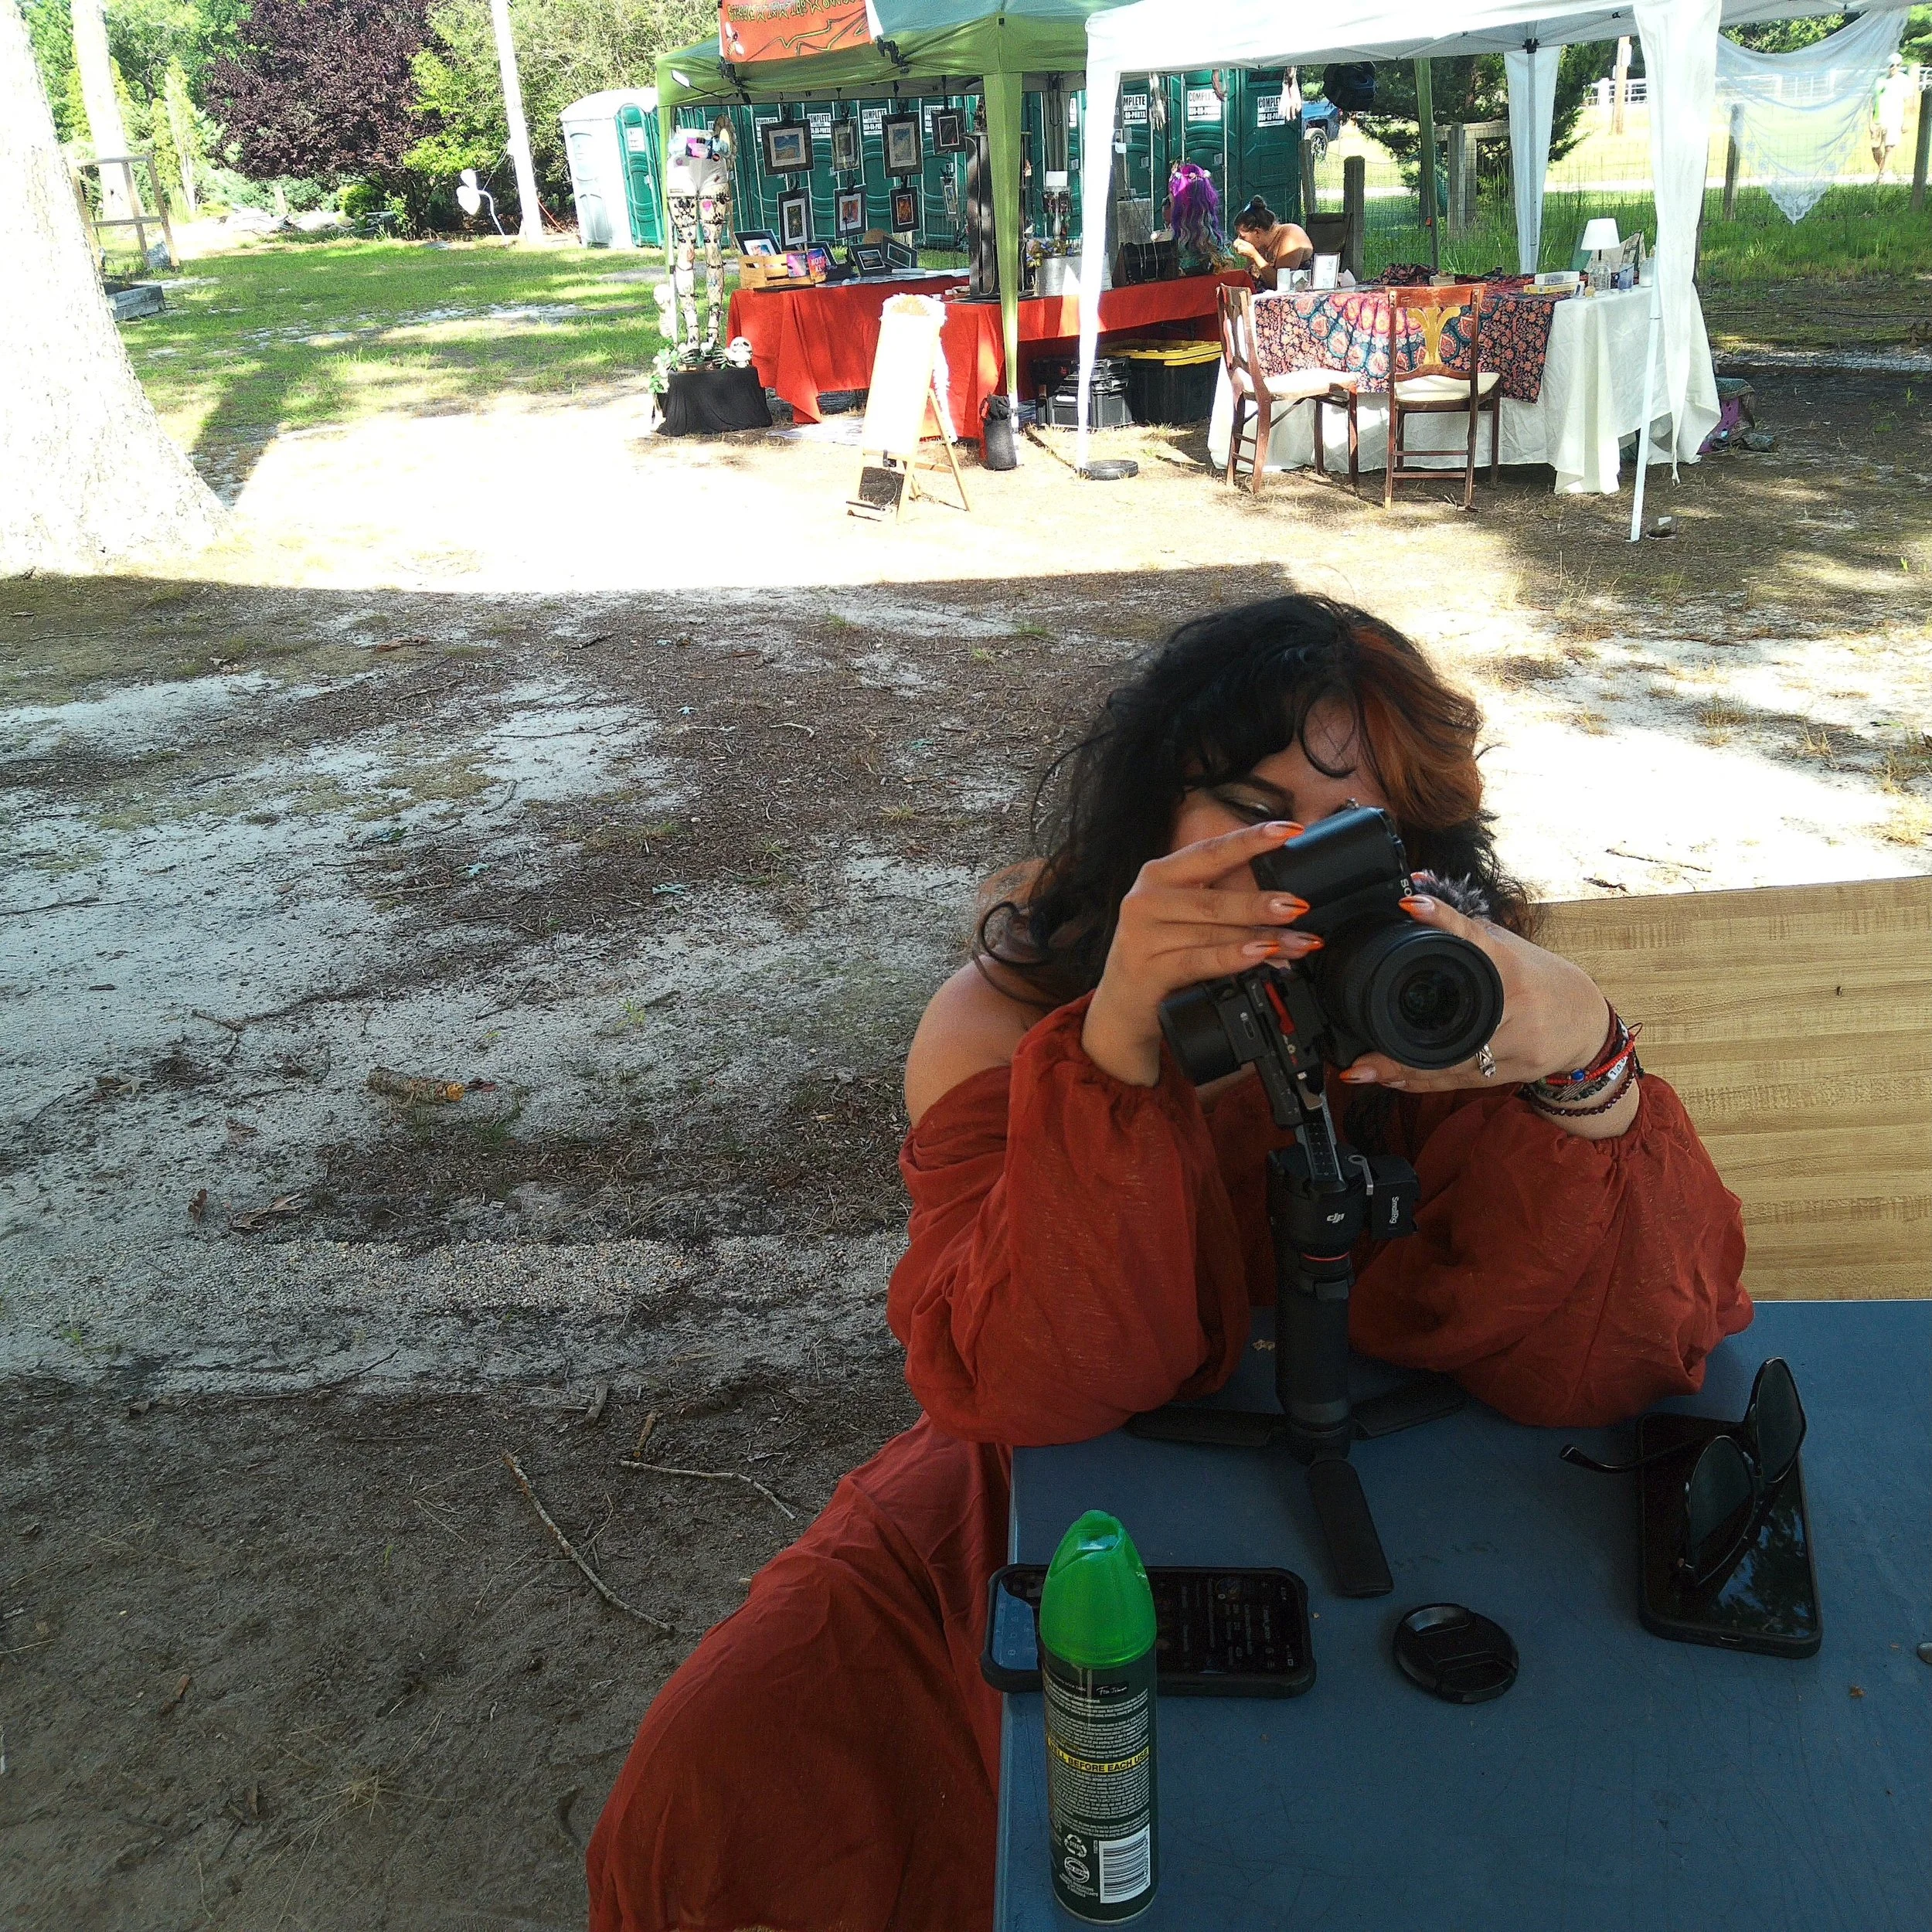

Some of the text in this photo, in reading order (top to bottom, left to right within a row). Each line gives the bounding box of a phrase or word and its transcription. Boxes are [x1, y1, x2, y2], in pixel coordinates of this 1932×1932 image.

[1400, 879, 1413, 896] SO
[1068, 1757, 1105, 1772] BEFORE
[1107, 1759, 1132, 1772] EACH
[1134, 1749, 1148, 1763] USE
